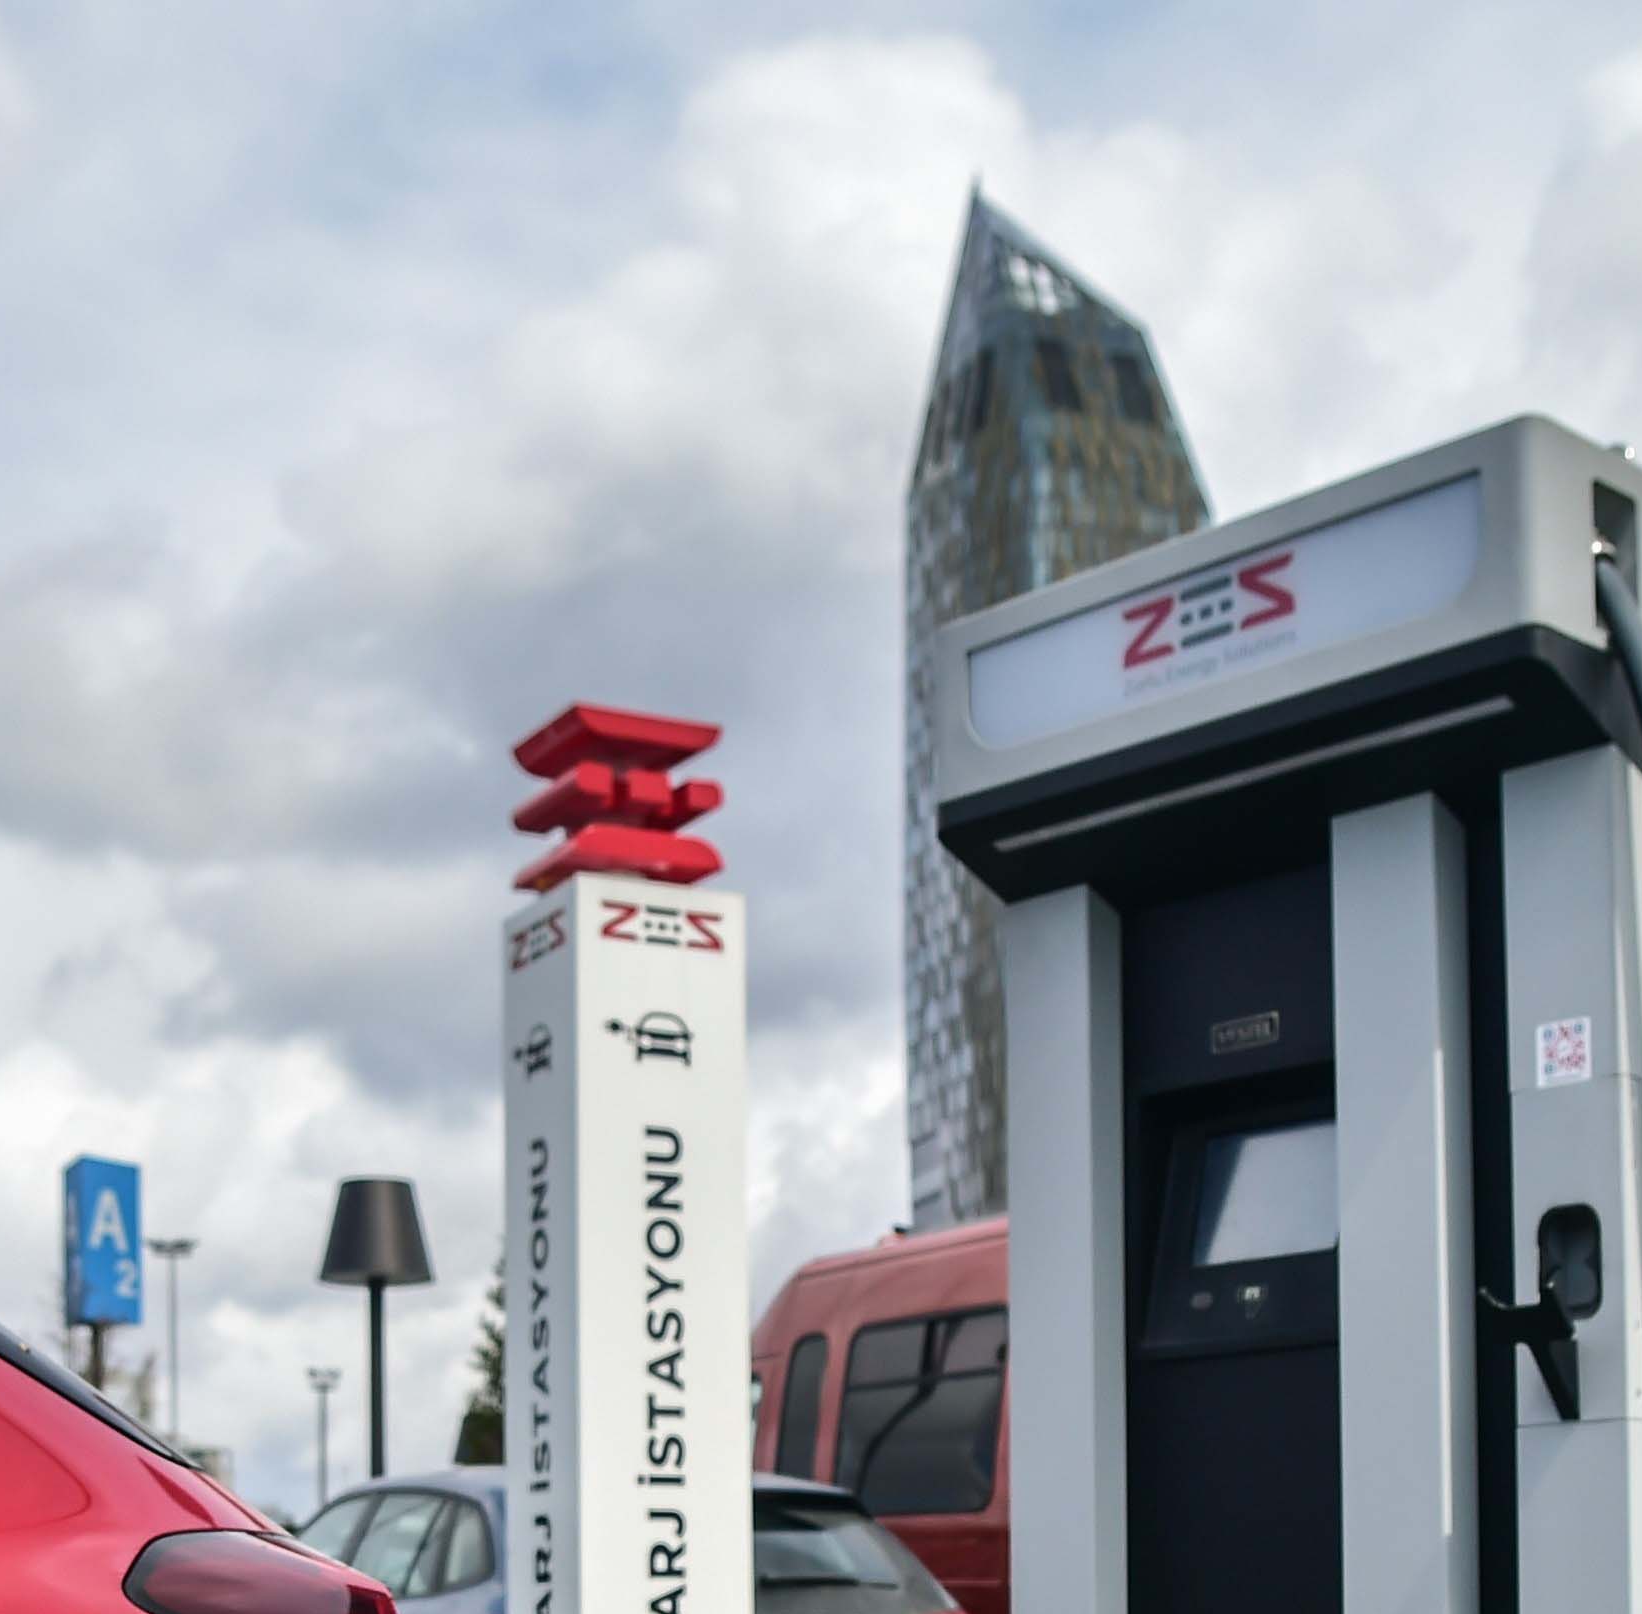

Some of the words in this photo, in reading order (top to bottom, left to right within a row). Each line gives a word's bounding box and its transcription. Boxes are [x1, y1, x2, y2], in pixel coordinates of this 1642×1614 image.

[1122, 550, 1297, 669] ZES
[510, 908, 565, 970] ZES
[601, 899, 725, 952] ZES
[89, 1187, 129, 1250] A
[114, 1258, 138, 1298] 2
[638, 1125, 686, 1486] İSTASYONU
[528, 1136, 551, 1493] İSTASYONU
